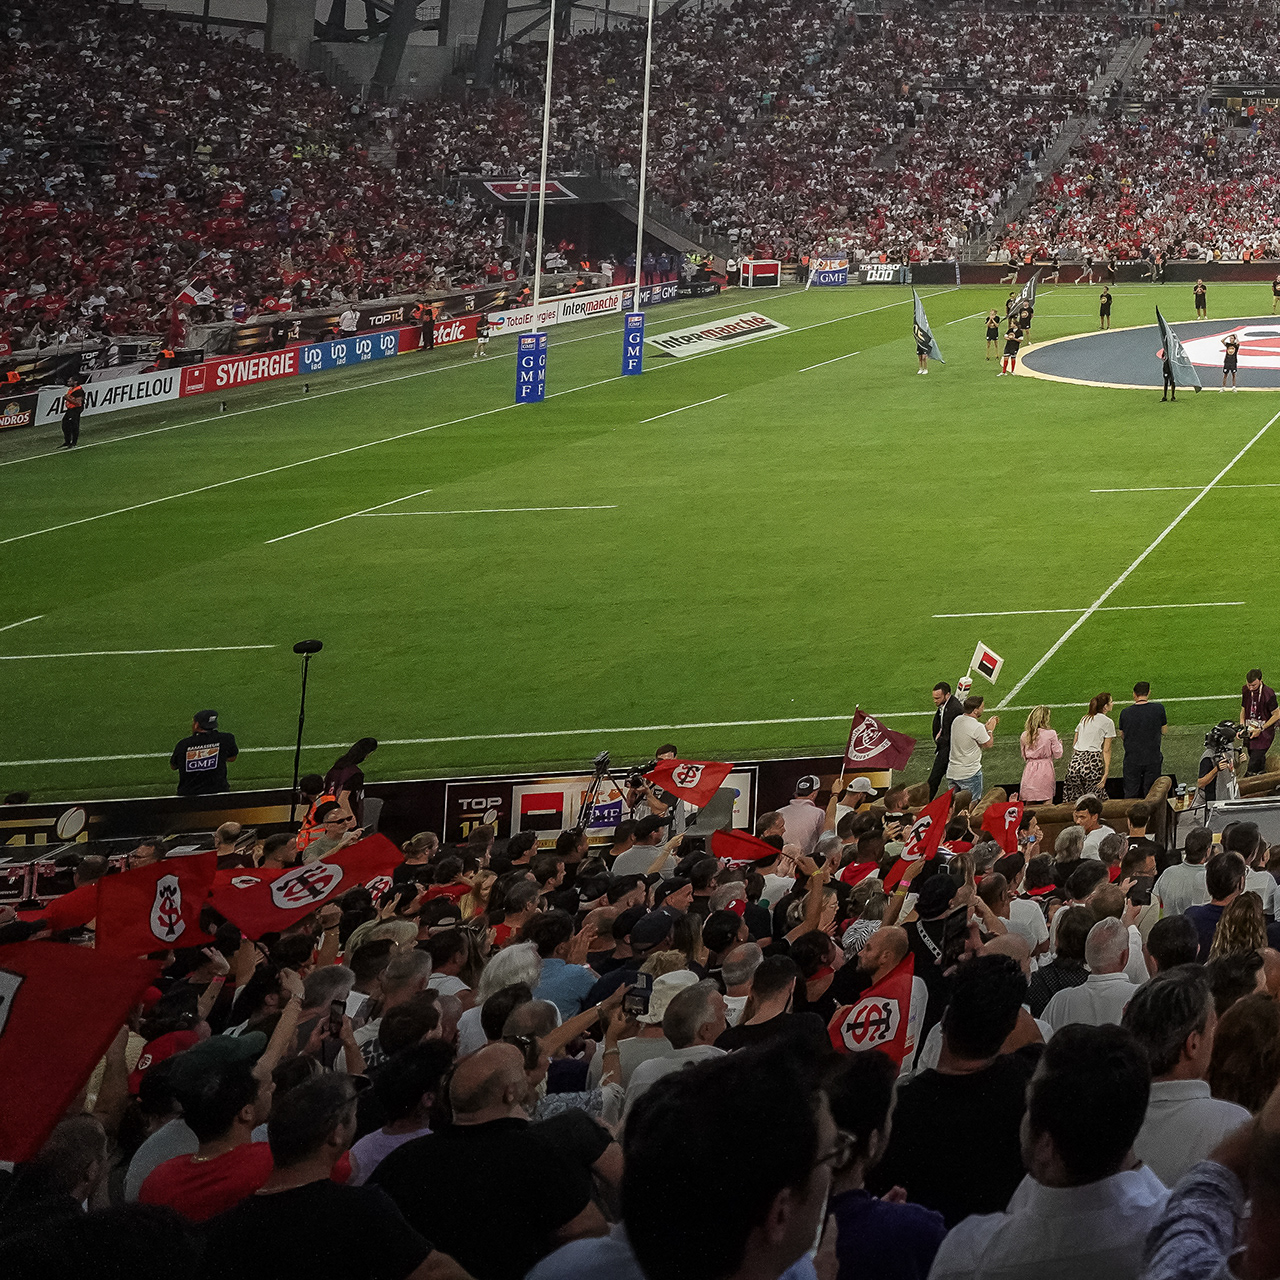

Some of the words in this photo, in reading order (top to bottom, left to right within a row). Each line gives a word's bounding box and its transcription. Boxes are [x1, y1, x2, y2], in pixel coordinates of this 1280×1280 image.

[868, 263, 900, 271] TISSO
[820, 274, 845, 283] GMF
[662, 286, 677, 299] GMF
[507, 309, 556, 328] TotalEnrgies
[418, 321, 466, 346] etclic
[216, 352, 294, 386] SYNERGIE
[46, 388, 99, 417] ALN
[100, 377, 173, 407] AFFLELOU
[0, 413, 30, 425] NDROS
[189, 758, 215, 769] GMF
[458, 797, 502, 810] TOP
